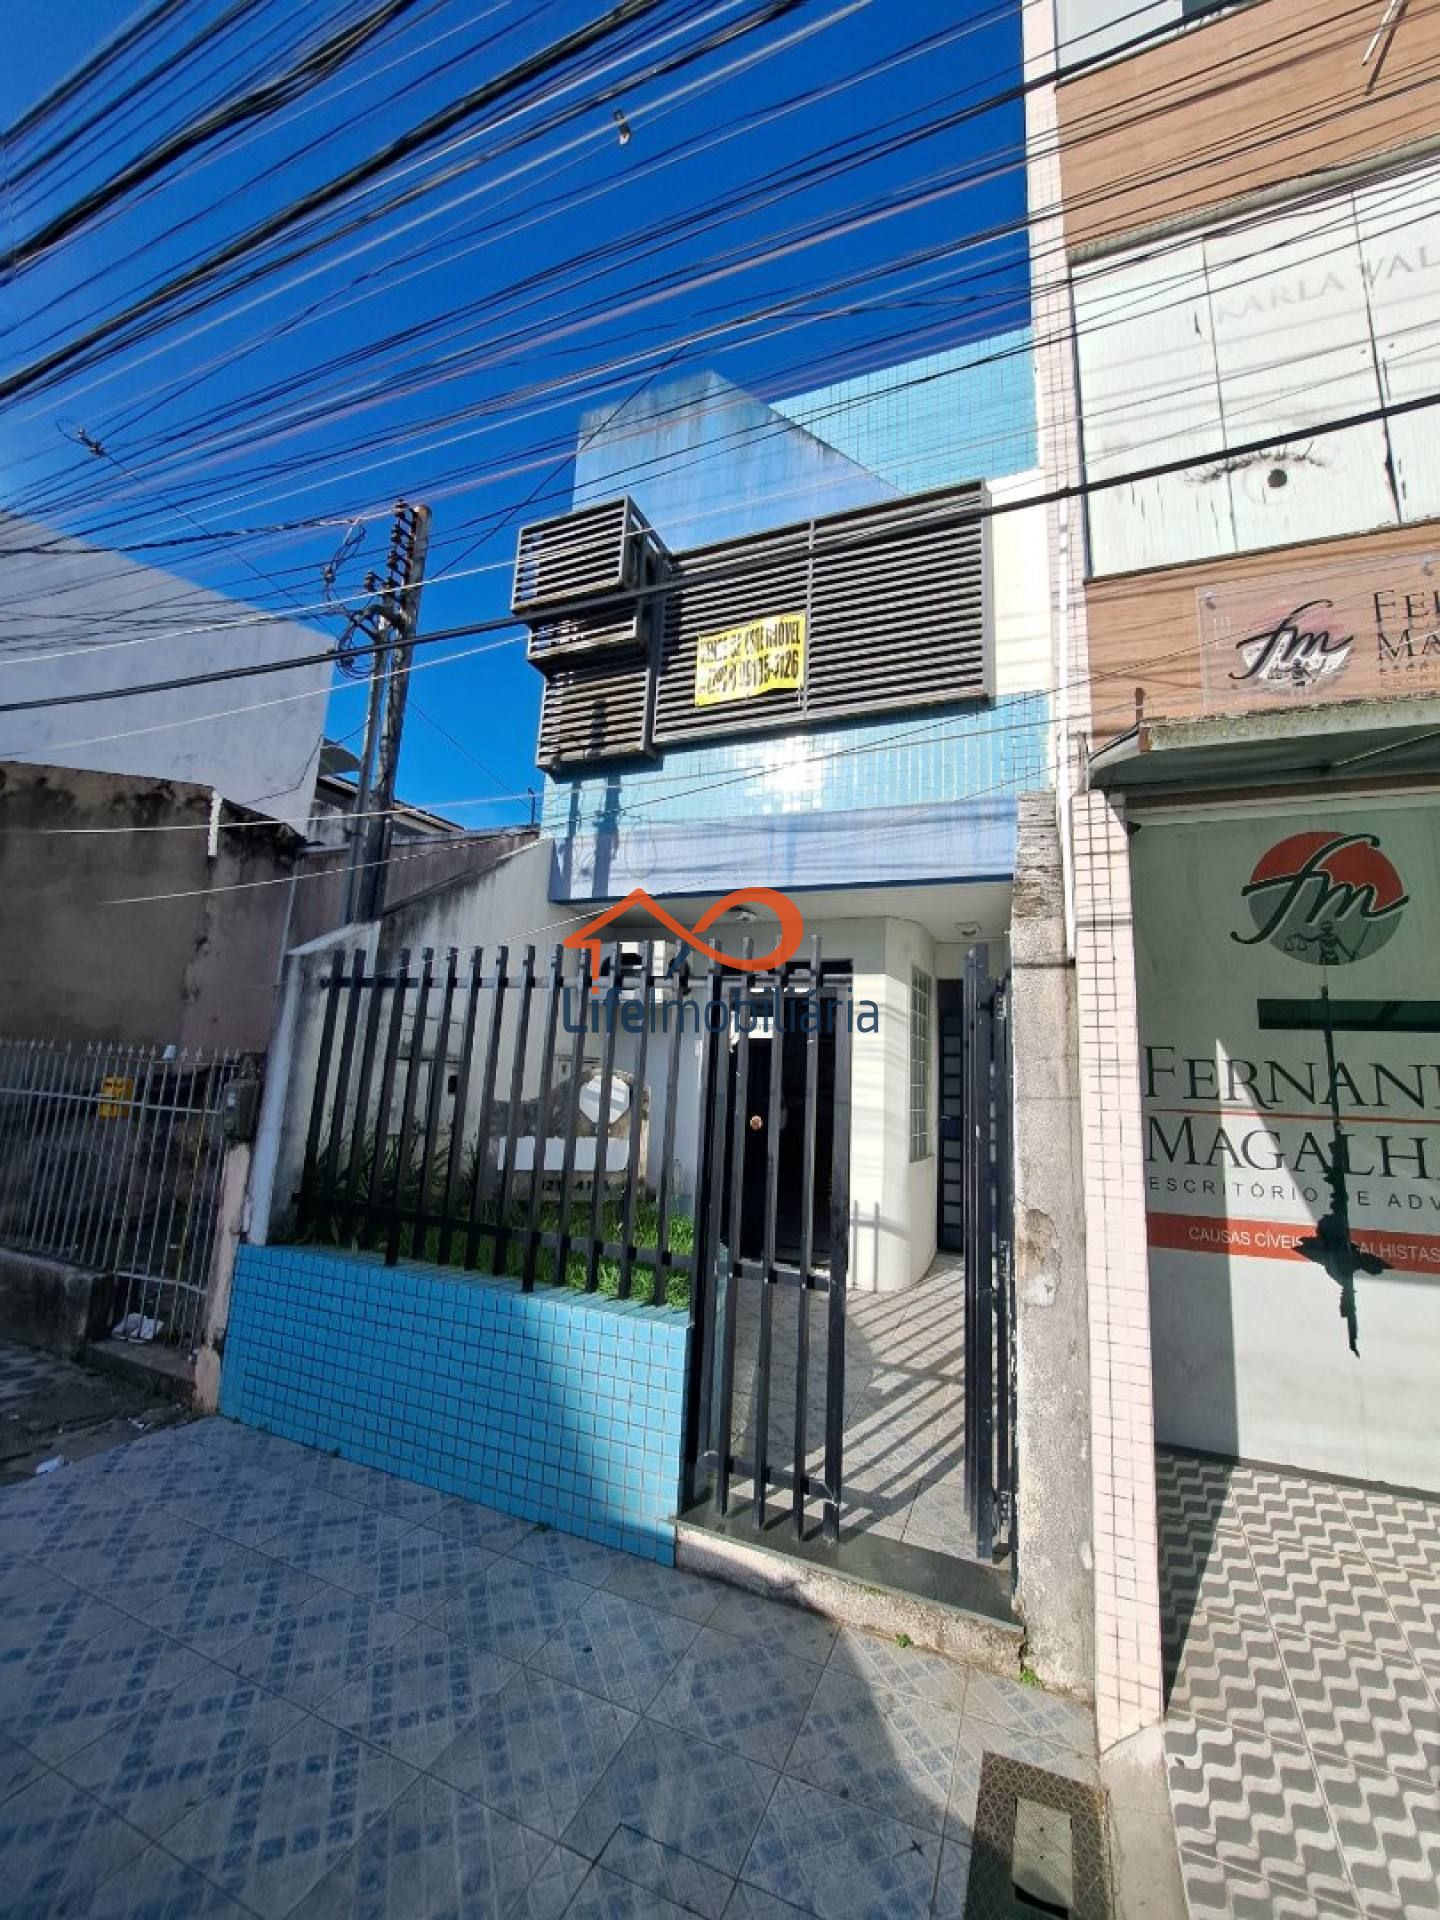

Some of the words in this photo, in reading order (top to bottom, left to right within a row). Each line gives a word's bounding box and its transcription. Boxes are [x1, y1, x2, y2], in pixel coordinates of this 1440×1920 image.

[1149, 1176, 1319, 1203] ESCRITÓRIO
[1188, 1226, 1251, 1245] CAUSAS
[1357, 1241, 1440, 1263] ALHISTAS
